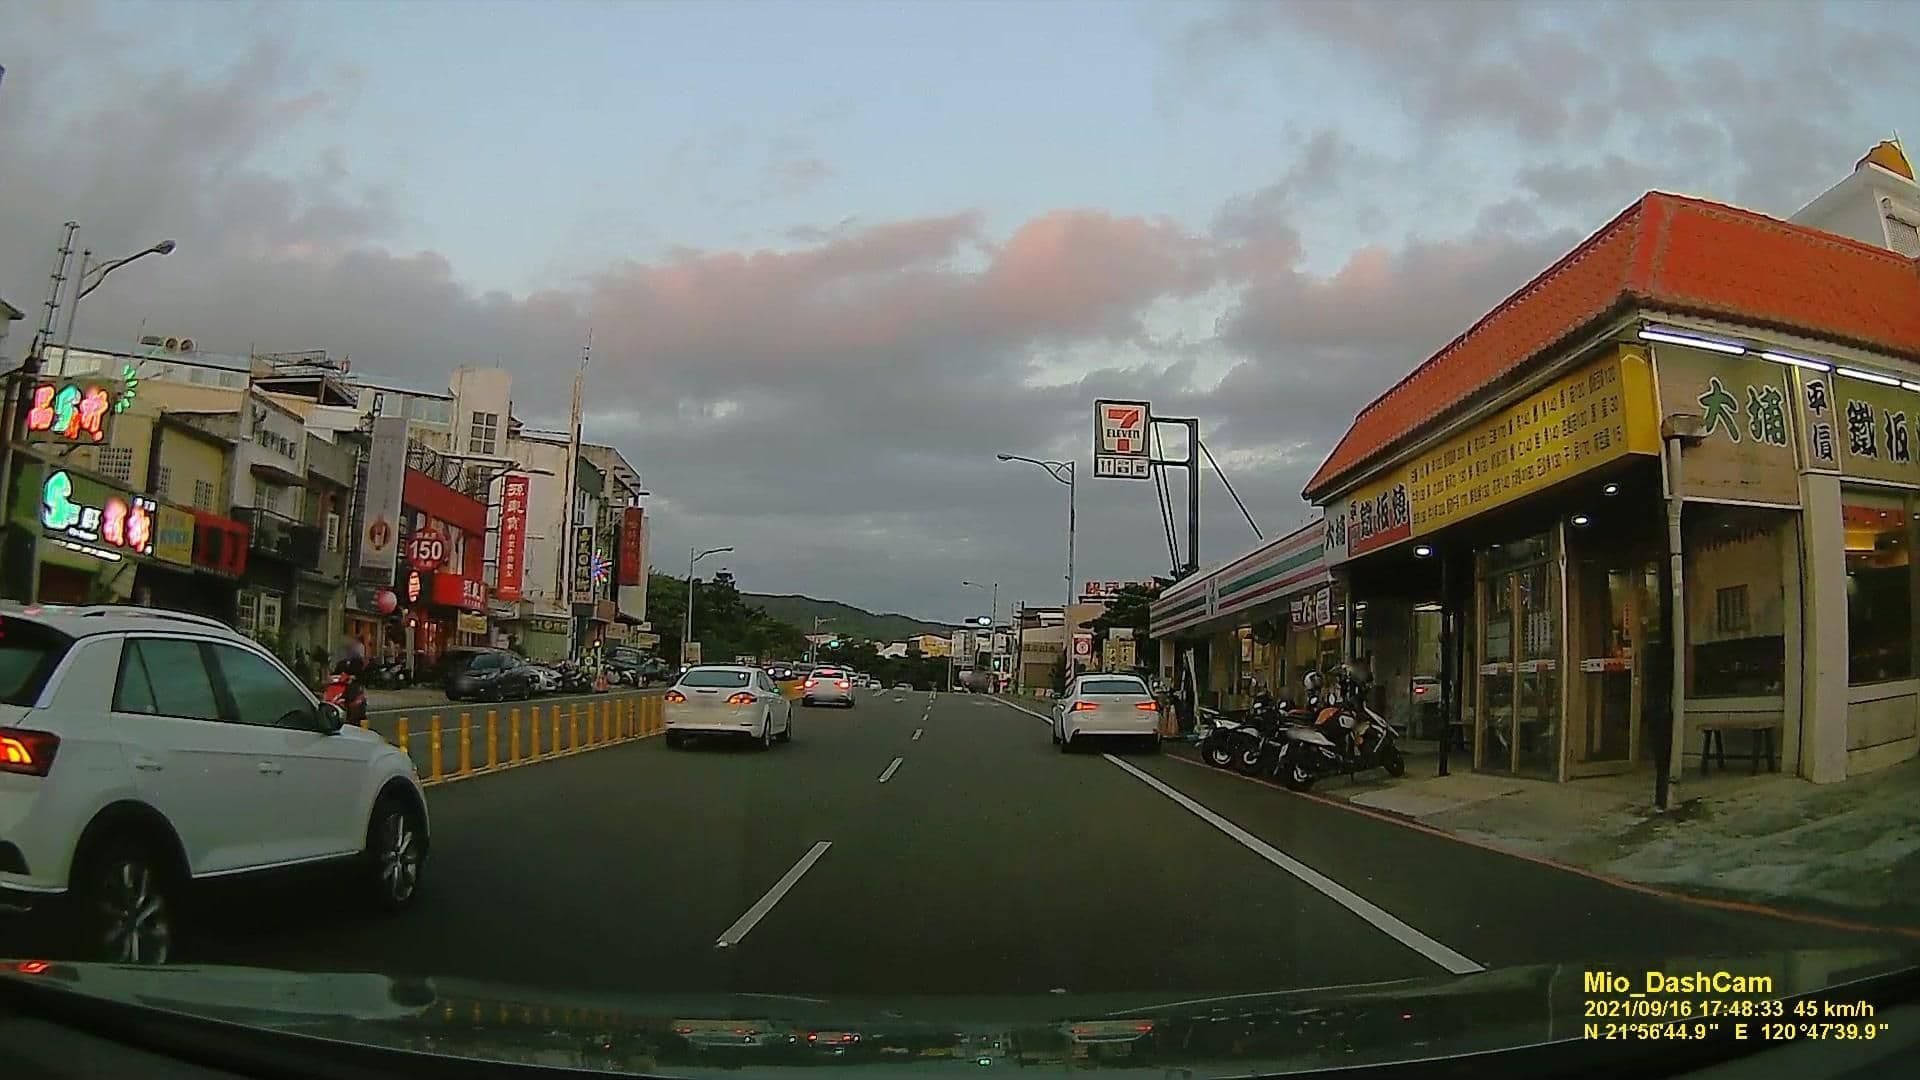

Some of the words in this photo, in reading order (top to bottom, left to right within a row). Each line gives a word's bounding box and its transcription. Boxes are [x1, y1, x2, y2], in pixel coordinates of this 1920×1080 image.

[1107, 408, 1140, 452] 7
[1847, 399, 1920, 464] 鐵板
[409, 539, 444, 561] 150
